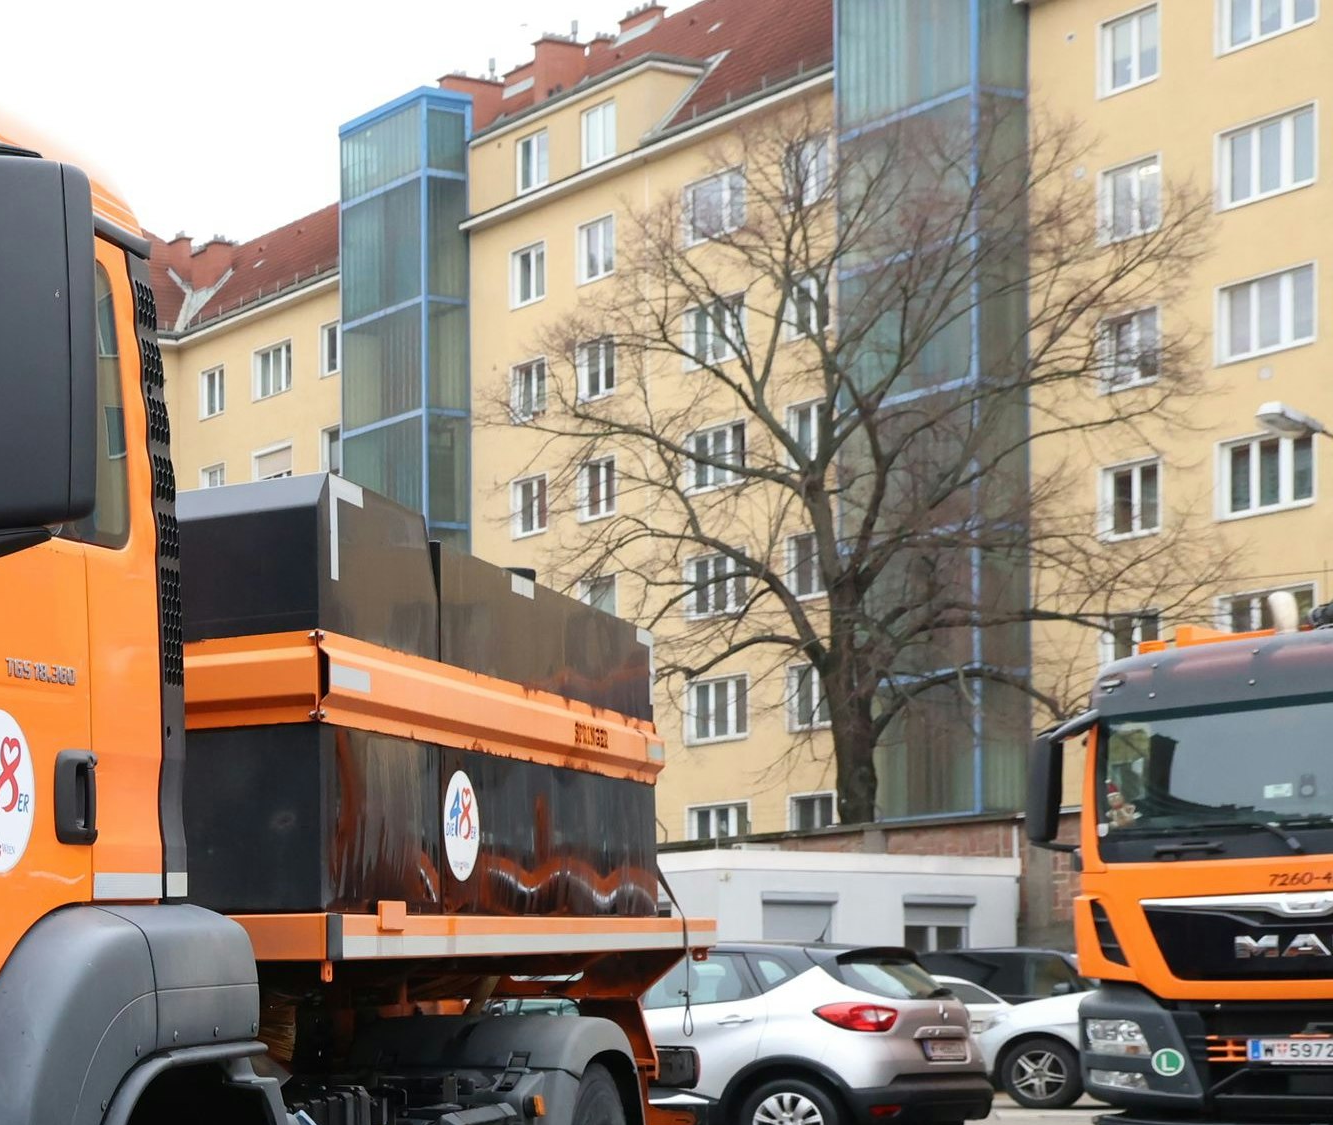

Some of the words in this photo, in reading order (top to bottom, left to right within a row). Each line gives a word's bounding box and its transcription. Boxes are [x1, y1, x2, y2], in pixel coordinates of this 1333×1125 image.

[574, 721, 609, 749] SPRINGER
[18, 793, 30, 813] ER
[449, 786, 472, 840] 48
